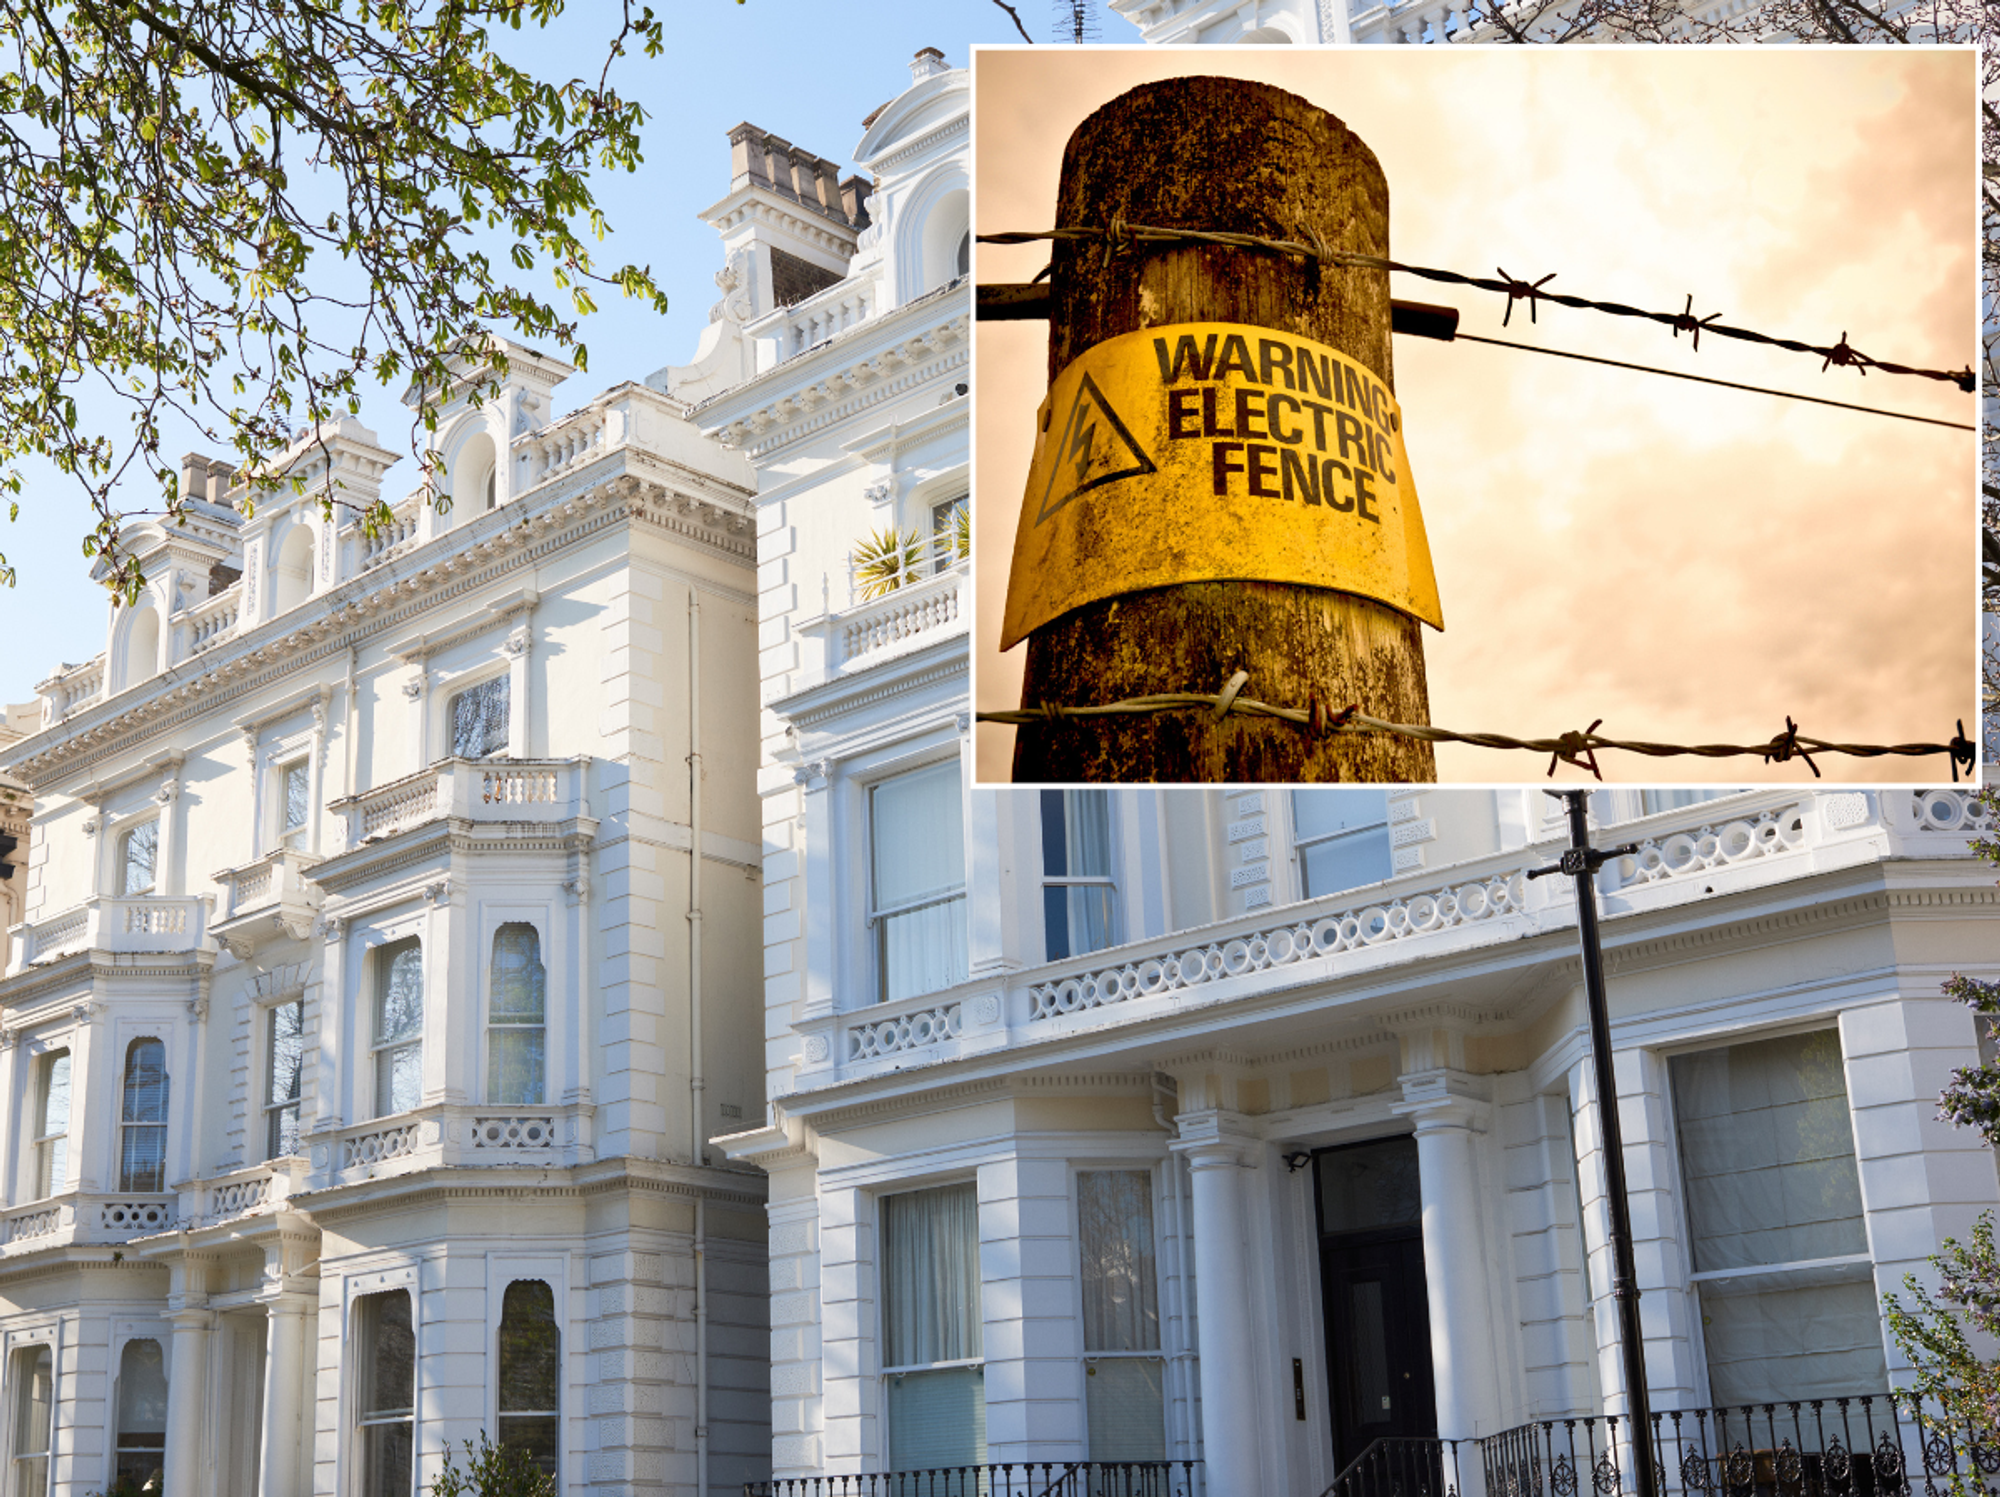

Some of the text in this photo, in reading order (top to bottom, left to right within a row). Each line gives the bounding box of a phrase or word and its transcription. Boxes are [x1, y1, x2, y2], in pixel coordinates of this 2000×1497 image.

[1153, 334, 1391, 437] WARNING
[1169, 387, 1396, 485] ELECTRIC
[1213, 442, 1380, 524] FENCE
